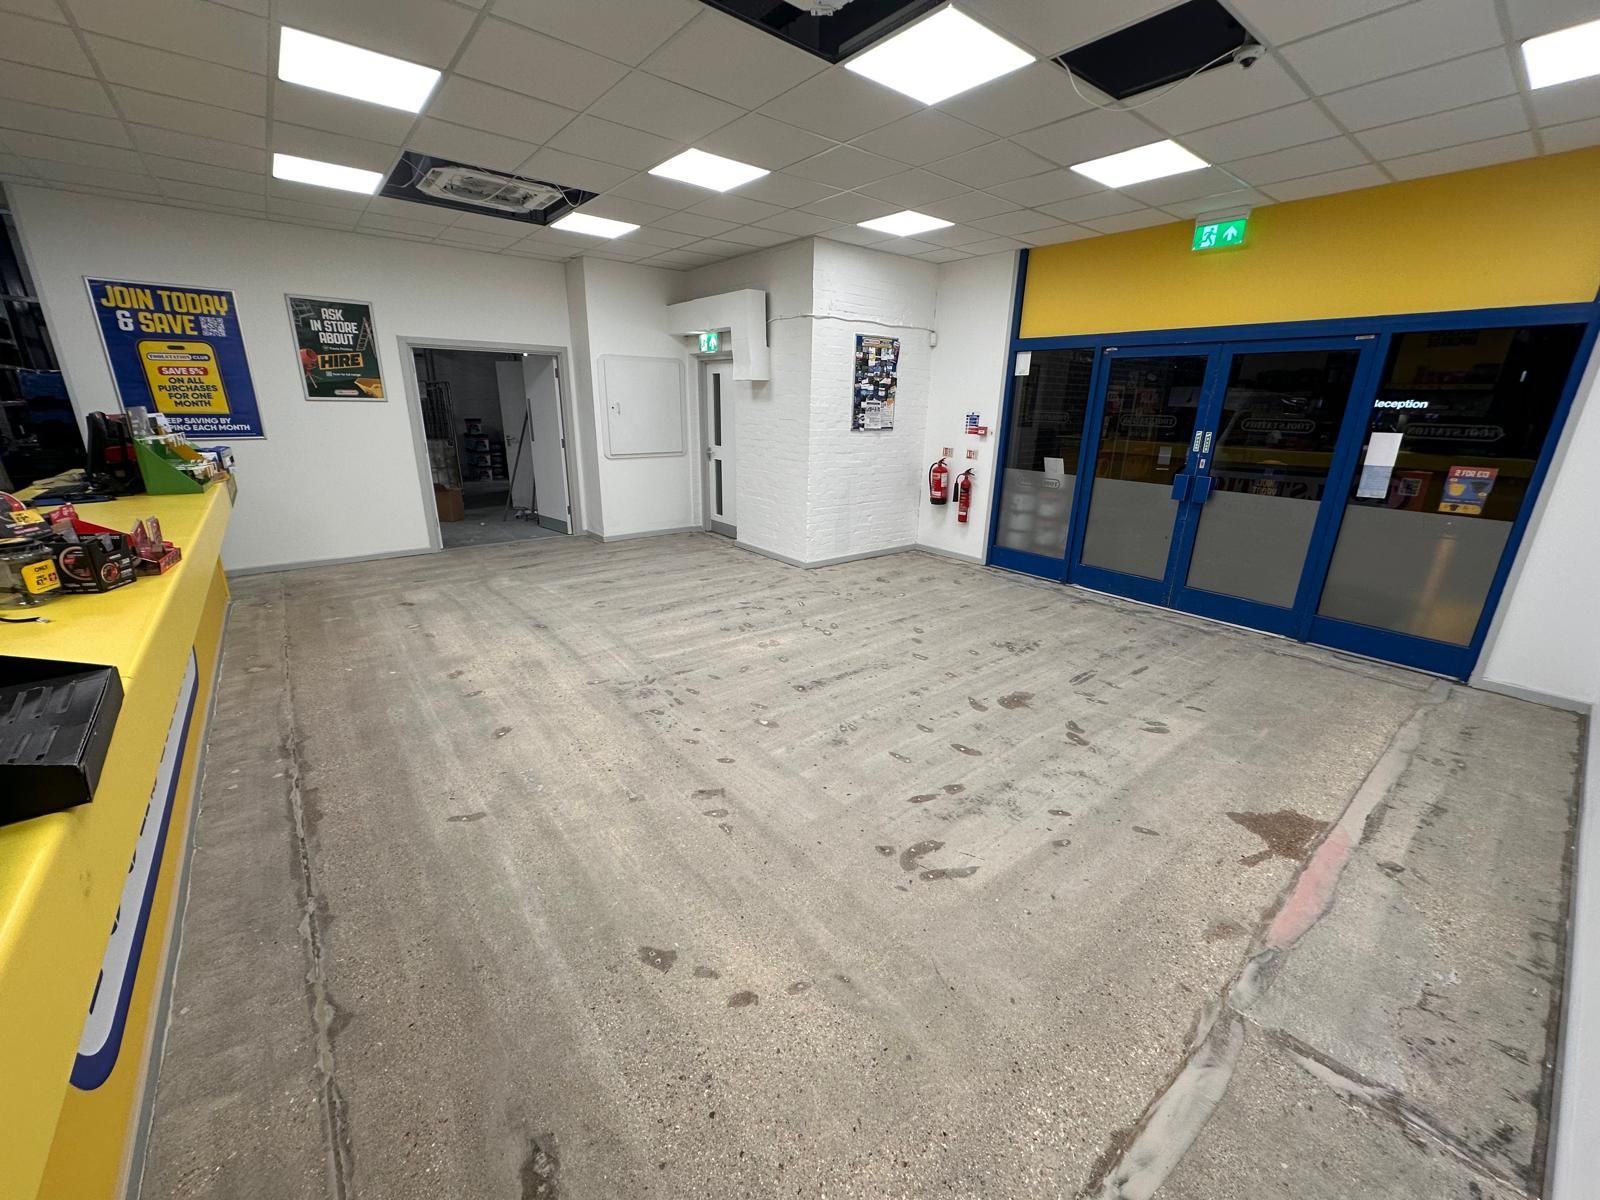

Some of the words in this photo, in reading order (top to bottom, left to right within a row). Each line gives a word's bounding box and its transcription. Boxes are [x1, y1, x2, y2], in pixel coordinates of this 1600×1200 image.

[101, 285, 154, 310] JOIN
[156, 290, 228, 315] TODAY
[321, 308, 344, 321] ASK
[116, 310, 134, 331] &
[138, 312, 198, 335] SAVE
[310, 319, 322, 331] IN
[324, 320, 359, 334] STORE
[319, 332, 353, 345] ABOUT
[320, 353, 361, 369] HIRE
[161, 367, 188, 375] SAVE
